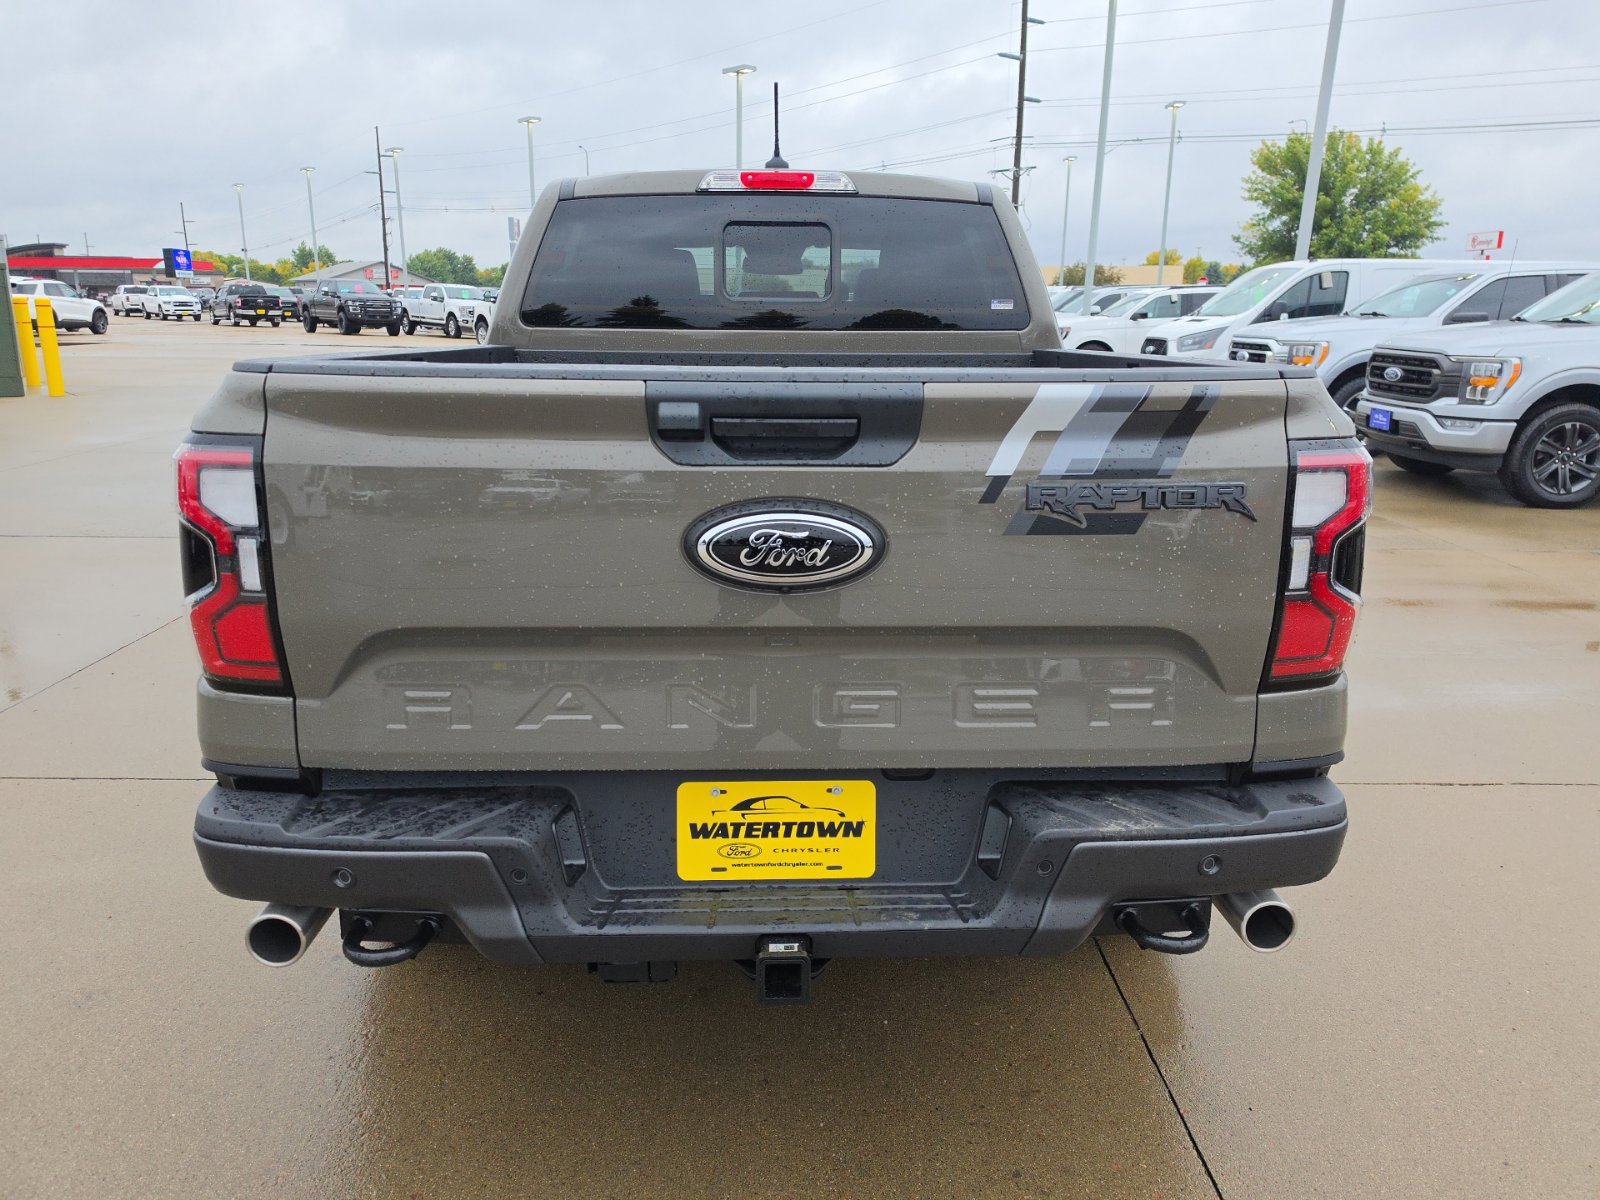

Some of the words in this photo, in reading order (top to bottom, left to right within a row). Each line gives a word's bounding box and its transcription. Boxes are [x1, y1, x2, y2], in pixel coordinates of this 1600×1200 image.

[1026, 481, 1257, 527] RAPTOR
[739, 528, 832, 567] Ford
[384, 680, 1174, 730] RANGER
[689, 821, 865, 840] WATERTOWN
[726, 845, 753, 857] Ford
